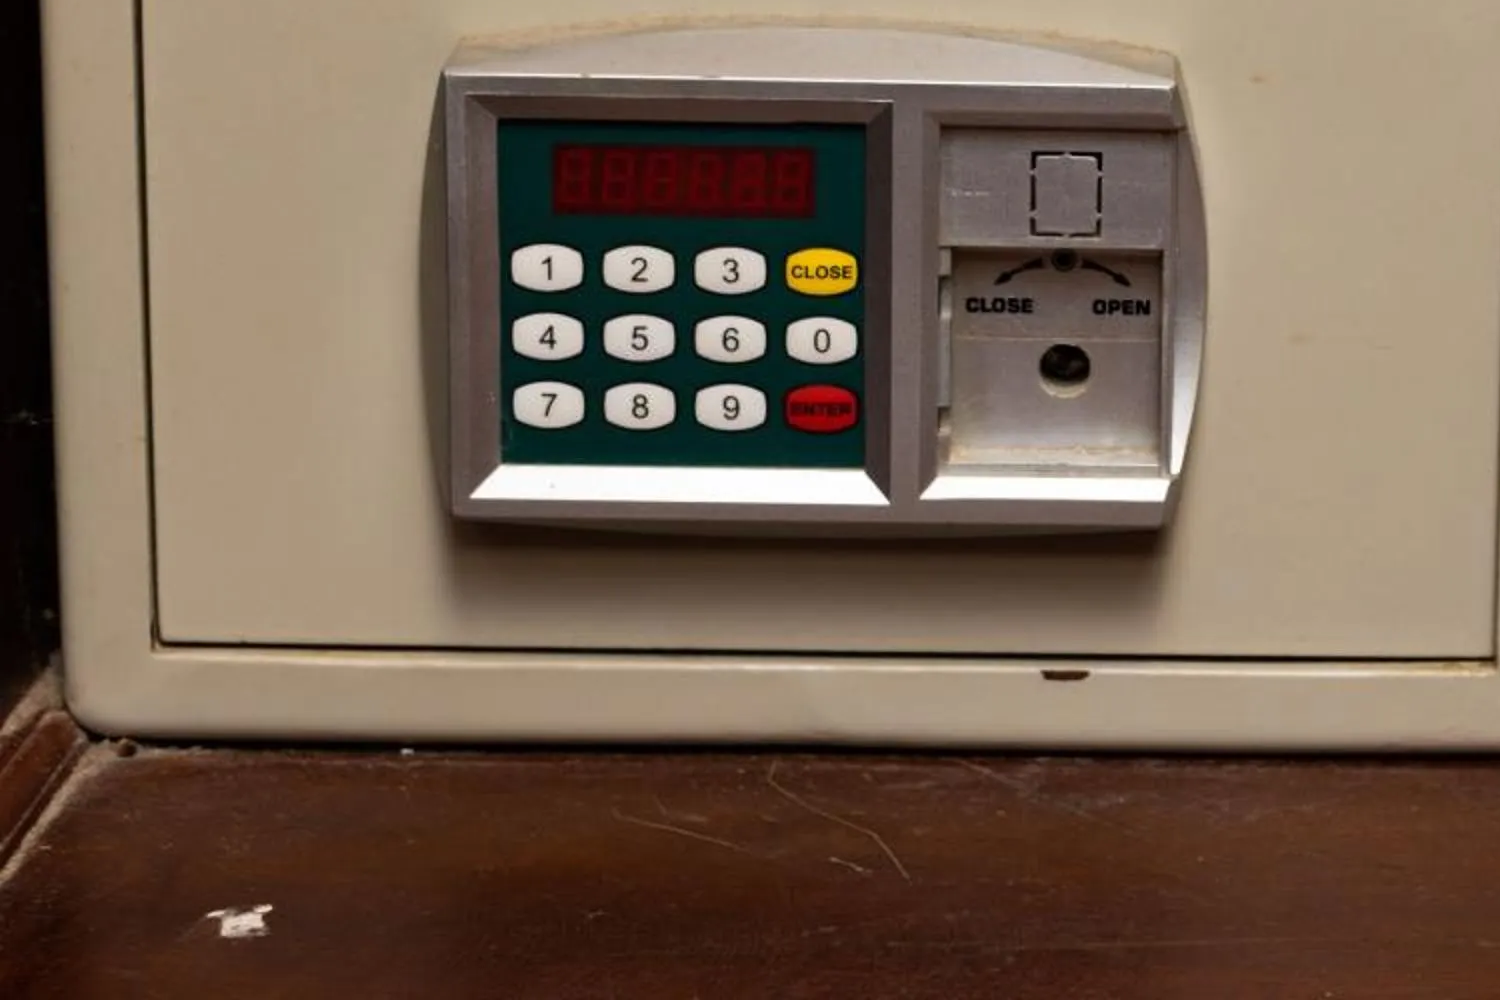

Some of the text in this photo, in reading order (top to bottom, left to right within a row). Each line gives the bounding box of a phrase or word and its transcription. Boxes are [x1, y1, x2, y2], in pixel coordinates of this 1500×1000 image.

[541, 256, 853, 284] 1 2 3 CLOSE
[965, 297, 1034, 314] CLOSE
[1092, 299, 1151, 316] OPEN
[538, 325, 831, 354] 4 5 6 0
[540, 392, 558, 418] 7
[631, 394, 649, 420] 8
[722, 395, 740, 421] 9
